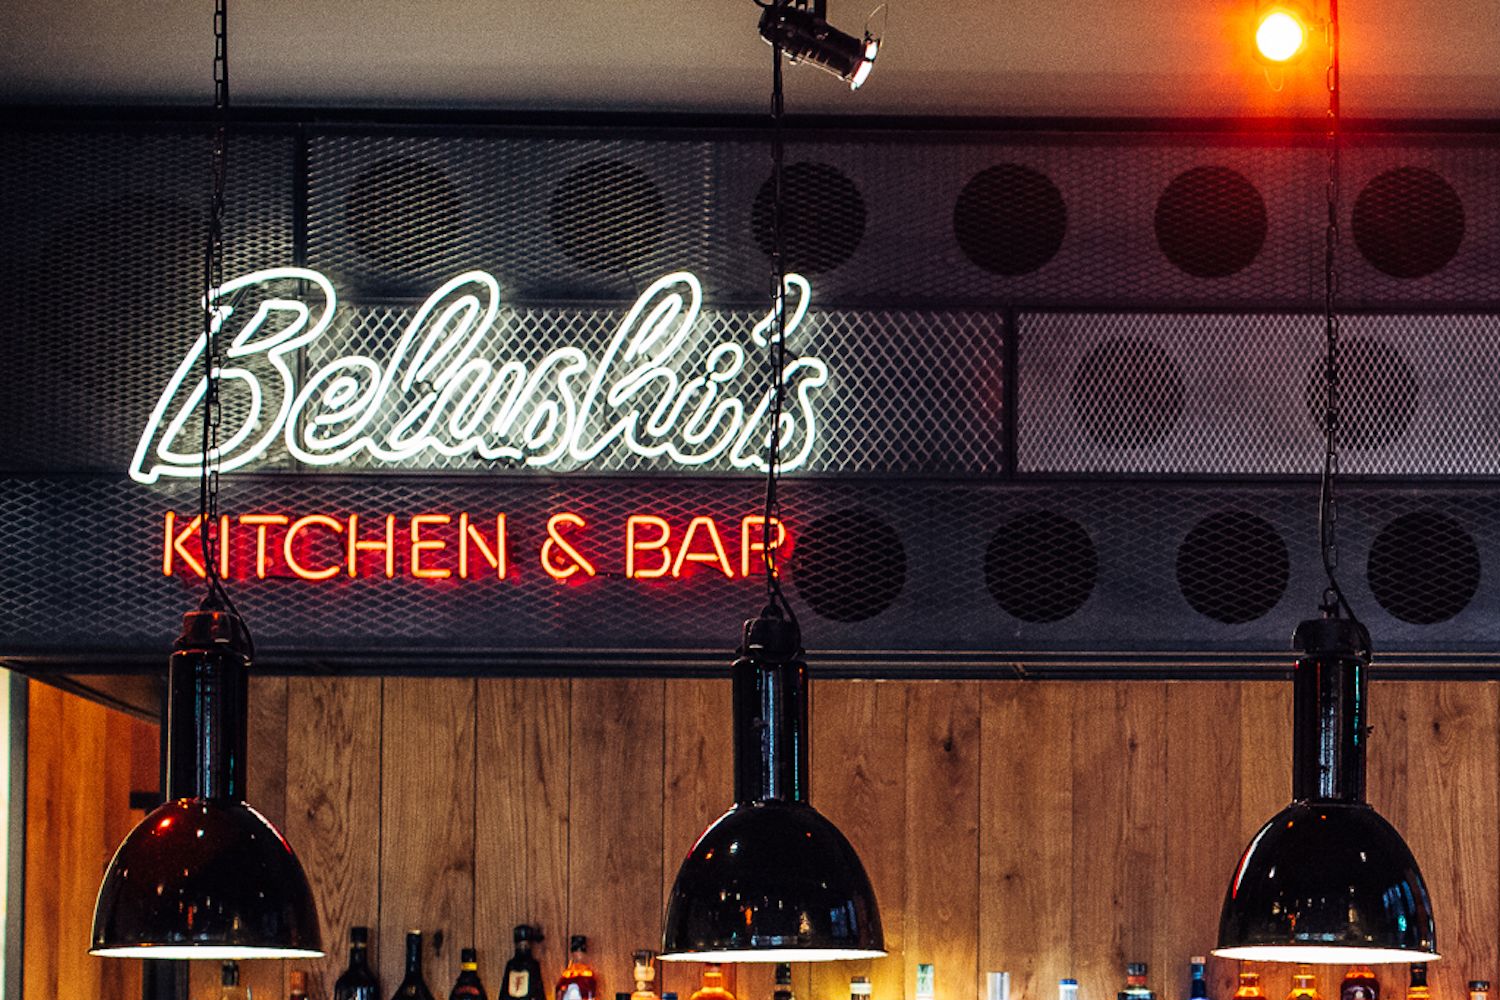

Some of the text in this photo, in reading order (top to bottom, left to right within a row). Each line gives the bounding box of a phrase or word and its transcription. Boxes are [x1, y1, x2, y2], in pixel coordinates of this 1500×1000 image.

[130, 267, 829, 484] Belushi's
[162, 510, 790, 580] KITCHEN & BAR
